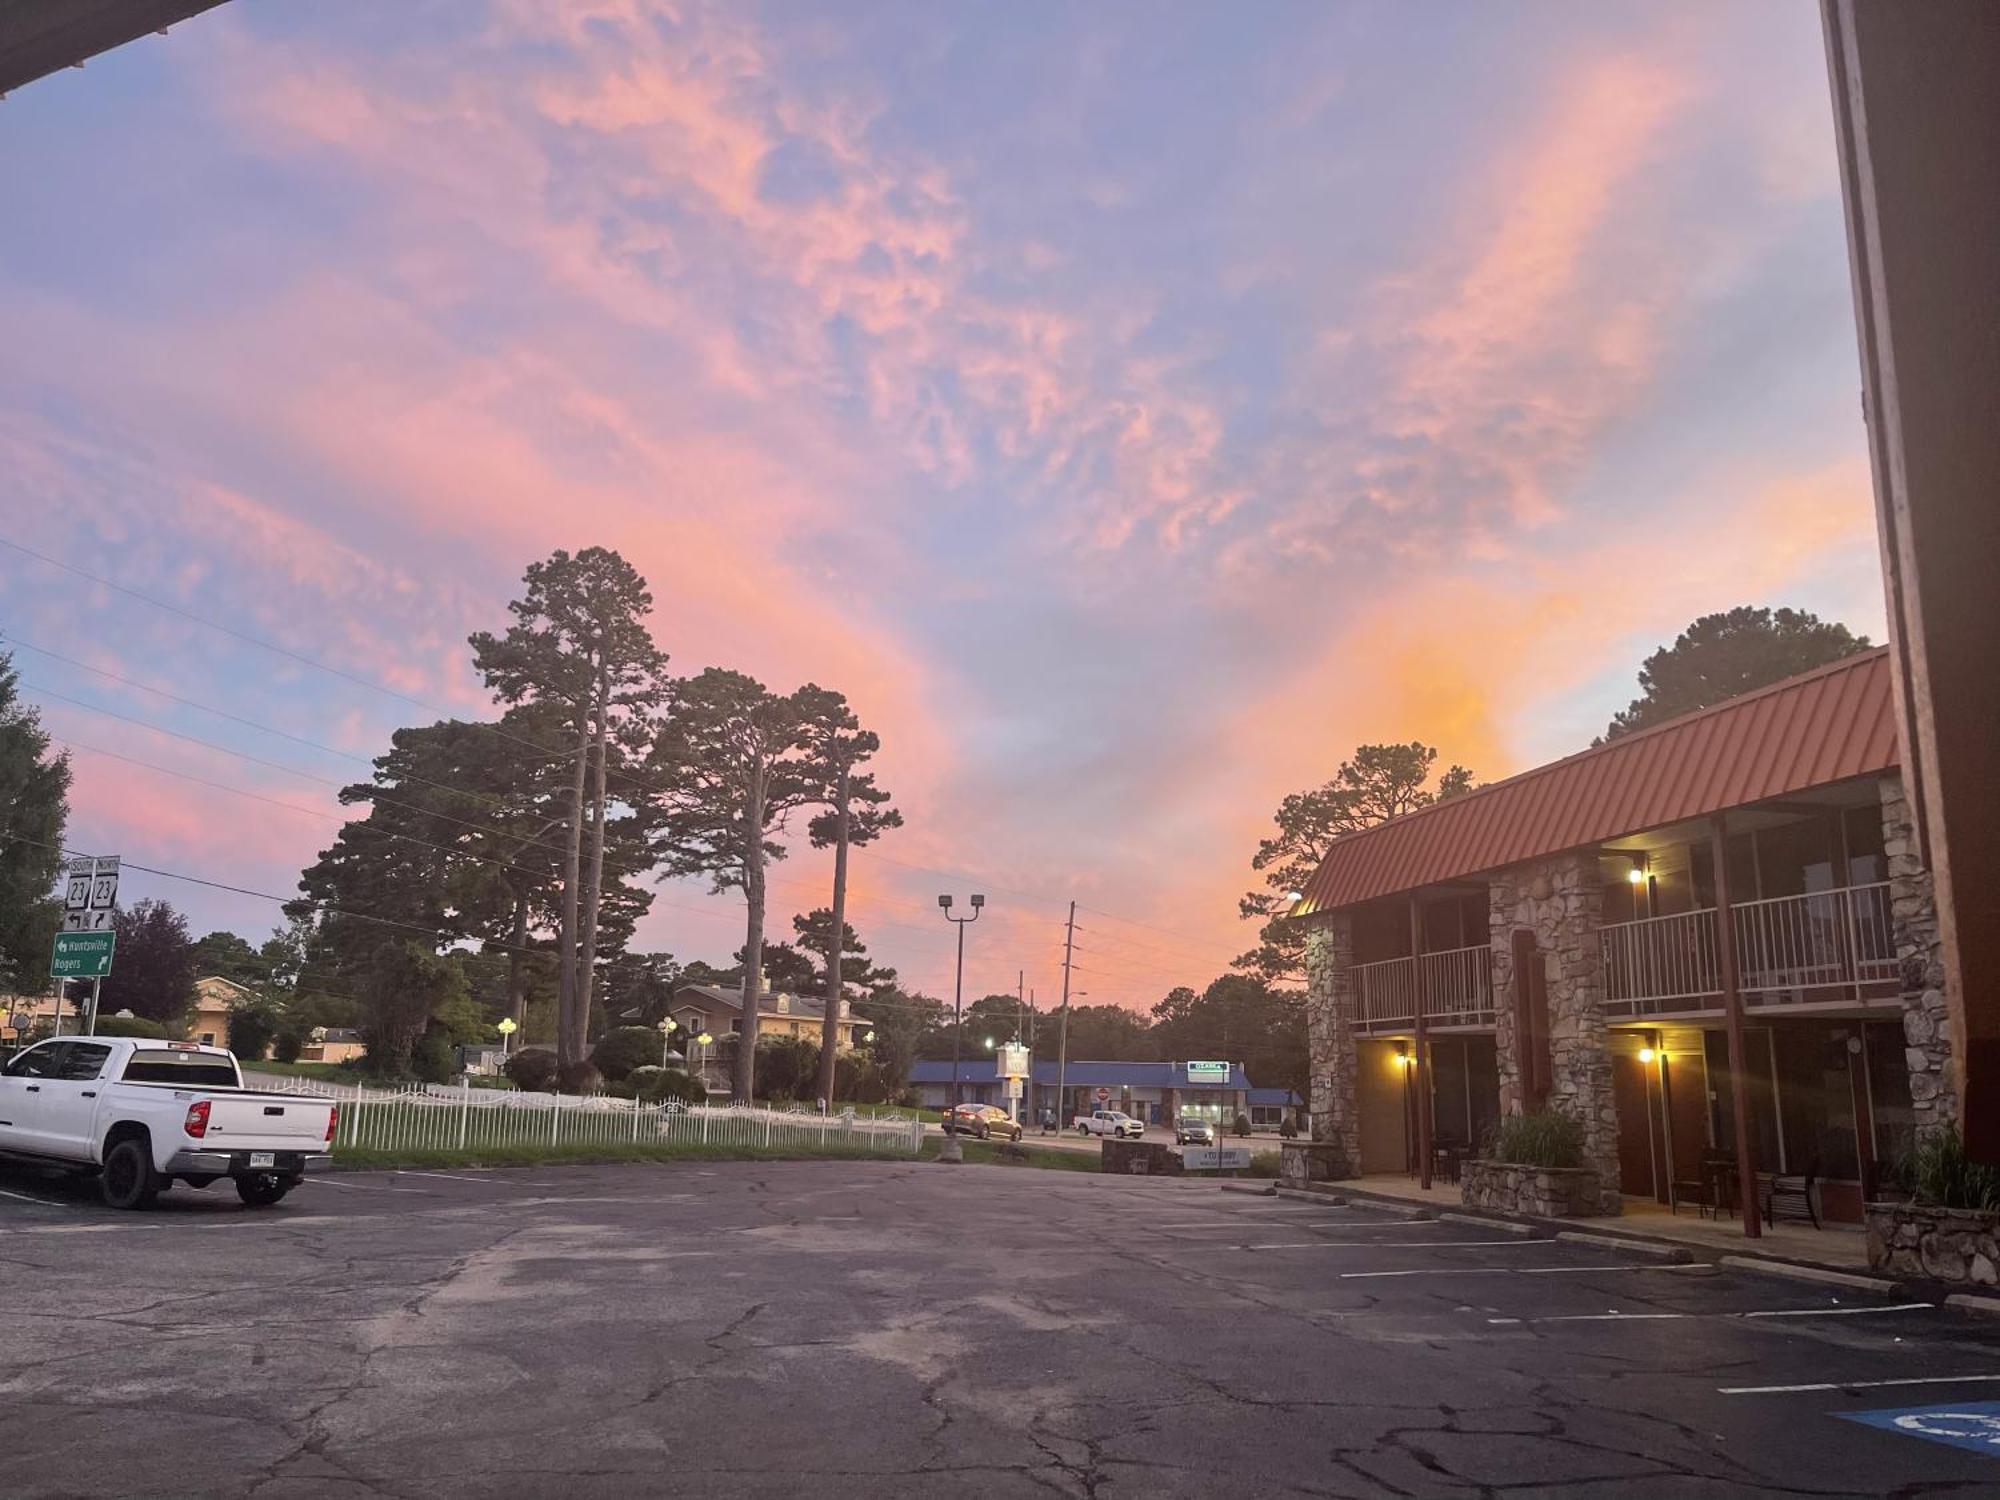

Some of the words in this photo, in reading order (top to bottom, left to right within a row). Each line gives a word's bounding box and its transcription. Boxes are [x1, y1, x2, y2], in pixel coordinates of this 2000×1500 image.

[71, 882, 85, 900] 23
[97, 881, 110, 899] 23
[69, 940, 107, 951] Huntsville
[55, 958, 80, 971] Rogers
